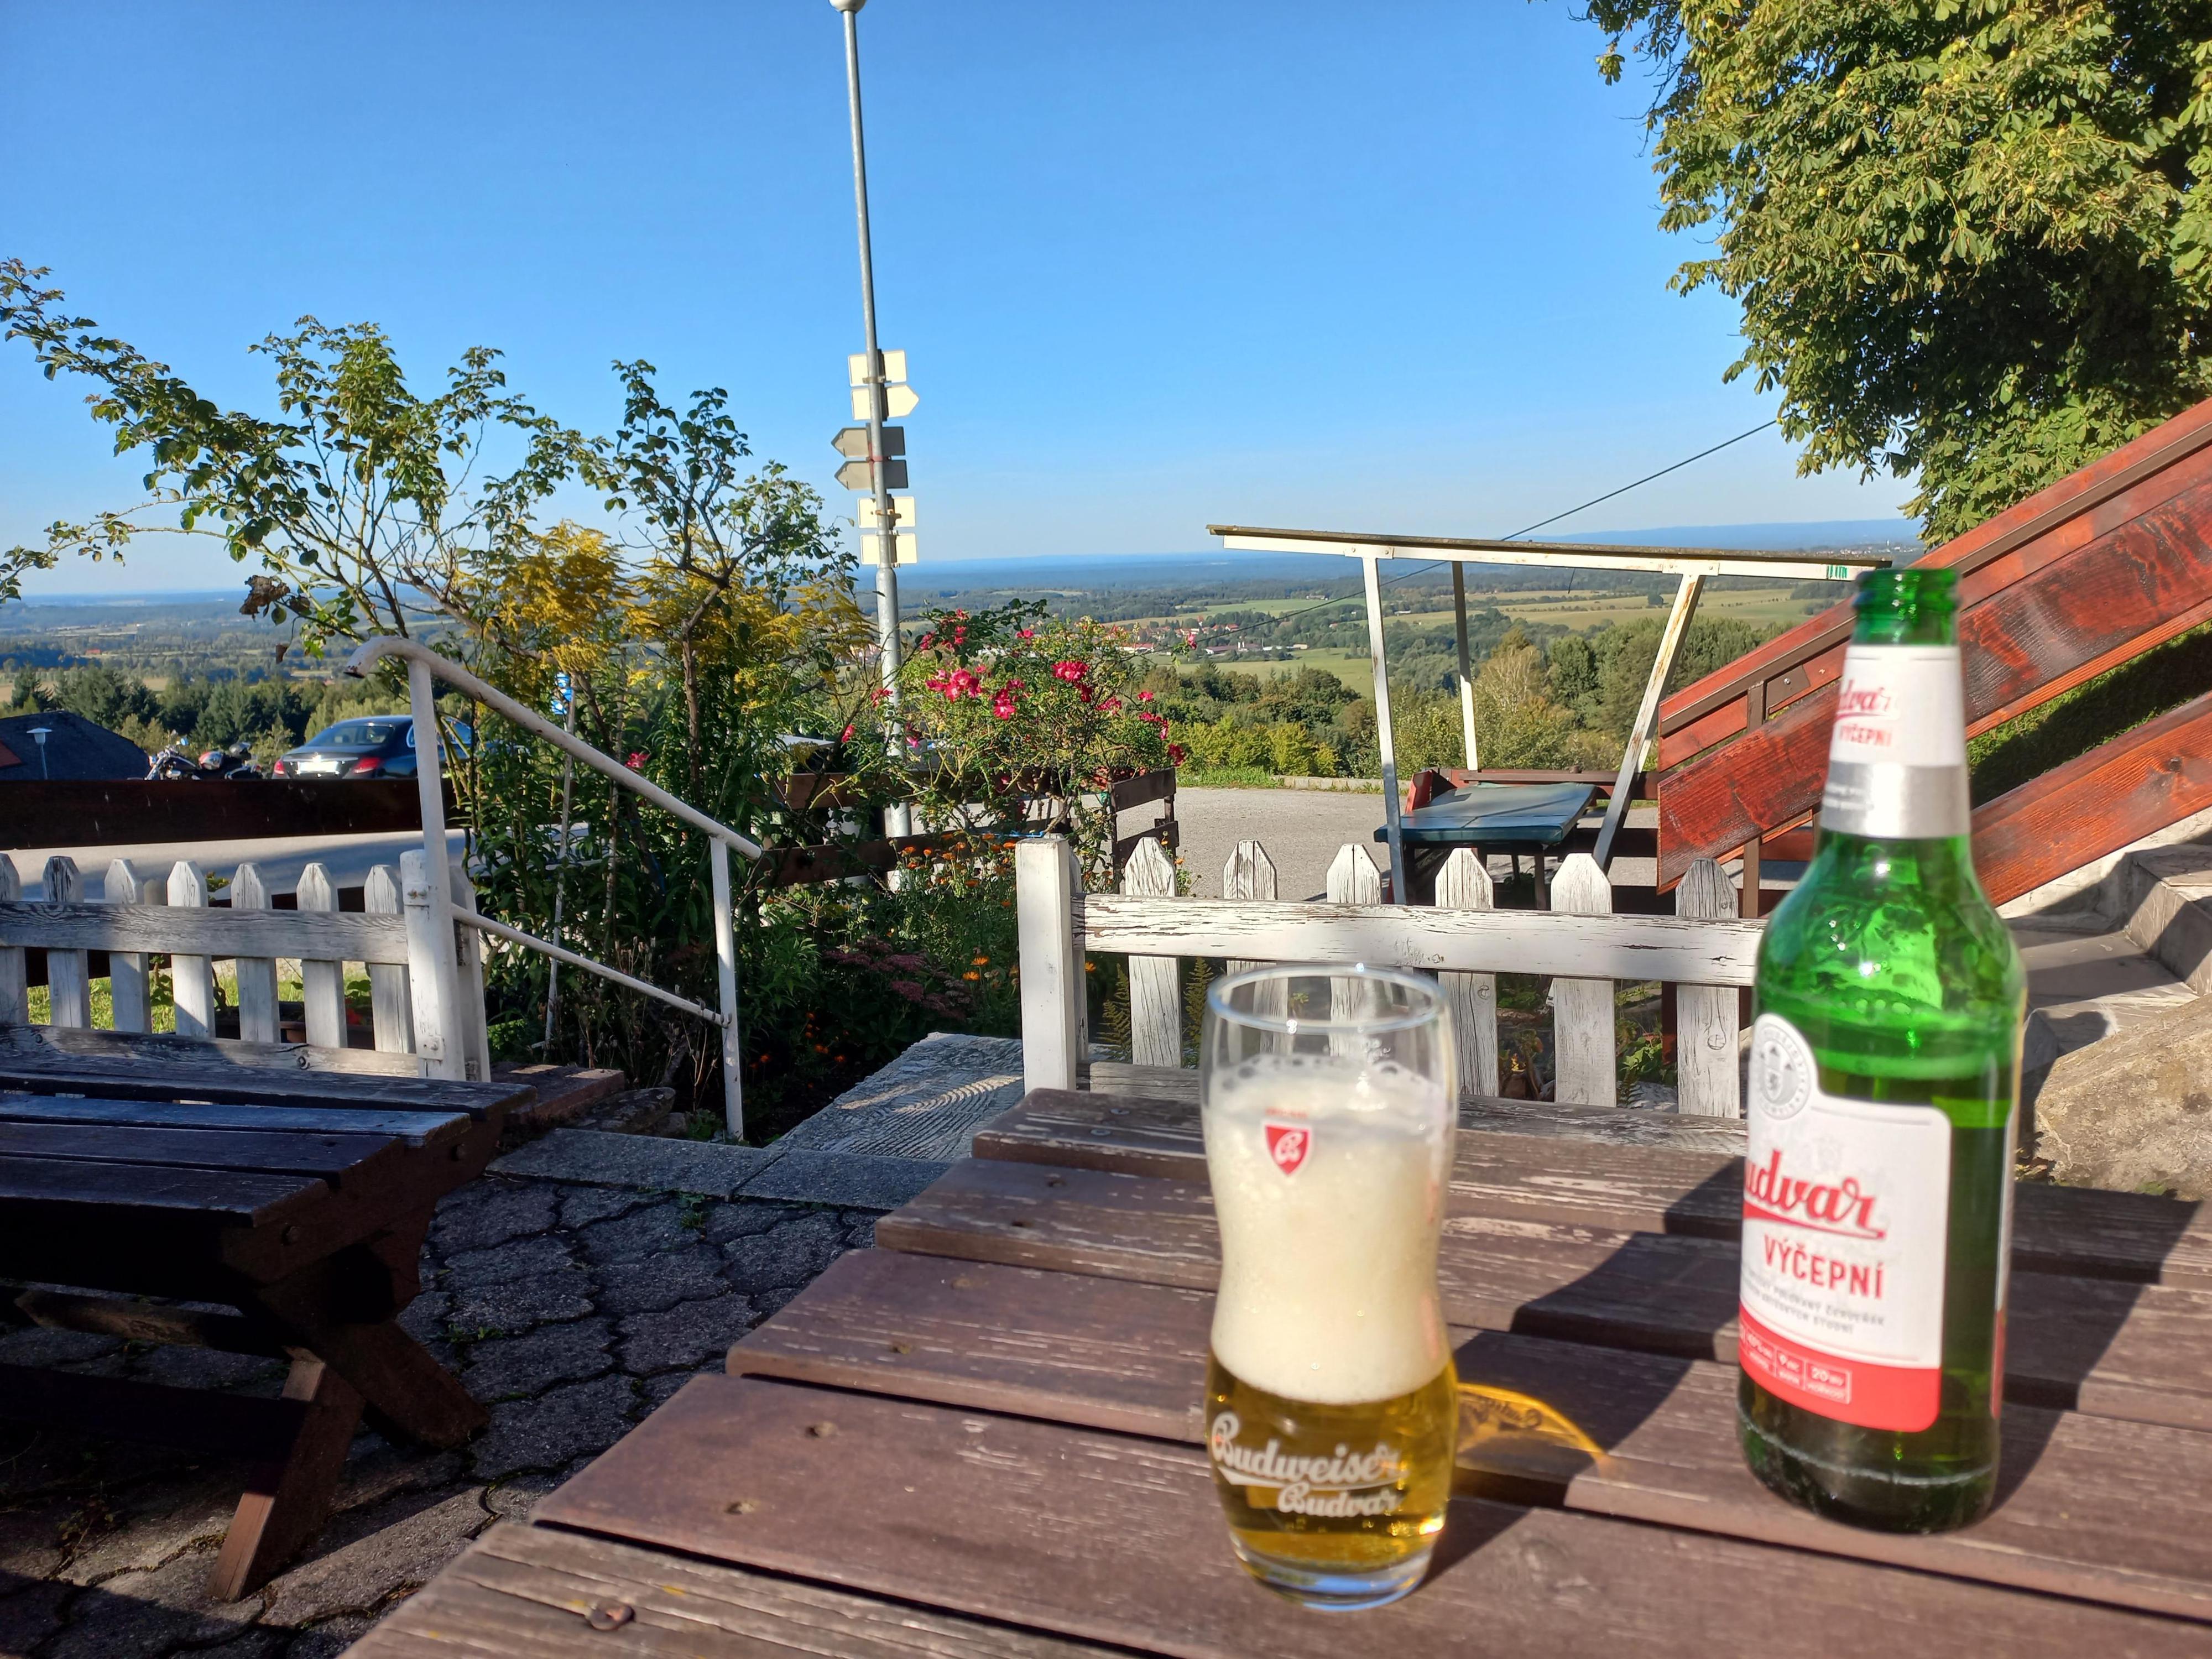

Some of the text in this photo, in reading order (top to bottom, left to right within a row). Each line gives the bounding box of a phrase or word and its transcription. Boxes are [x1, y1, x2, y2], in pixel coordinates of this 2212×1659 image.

[1744, 1149, 1885, 1239] udvar
[1764, 1233, 1884, 1300] VÝČEPNÍ
[1811, 1366, 1830, 1383] 20
[1211, 1412, 1408, 1484] Budweiser
[1277, 1481, 1401, 1518] Budvar
